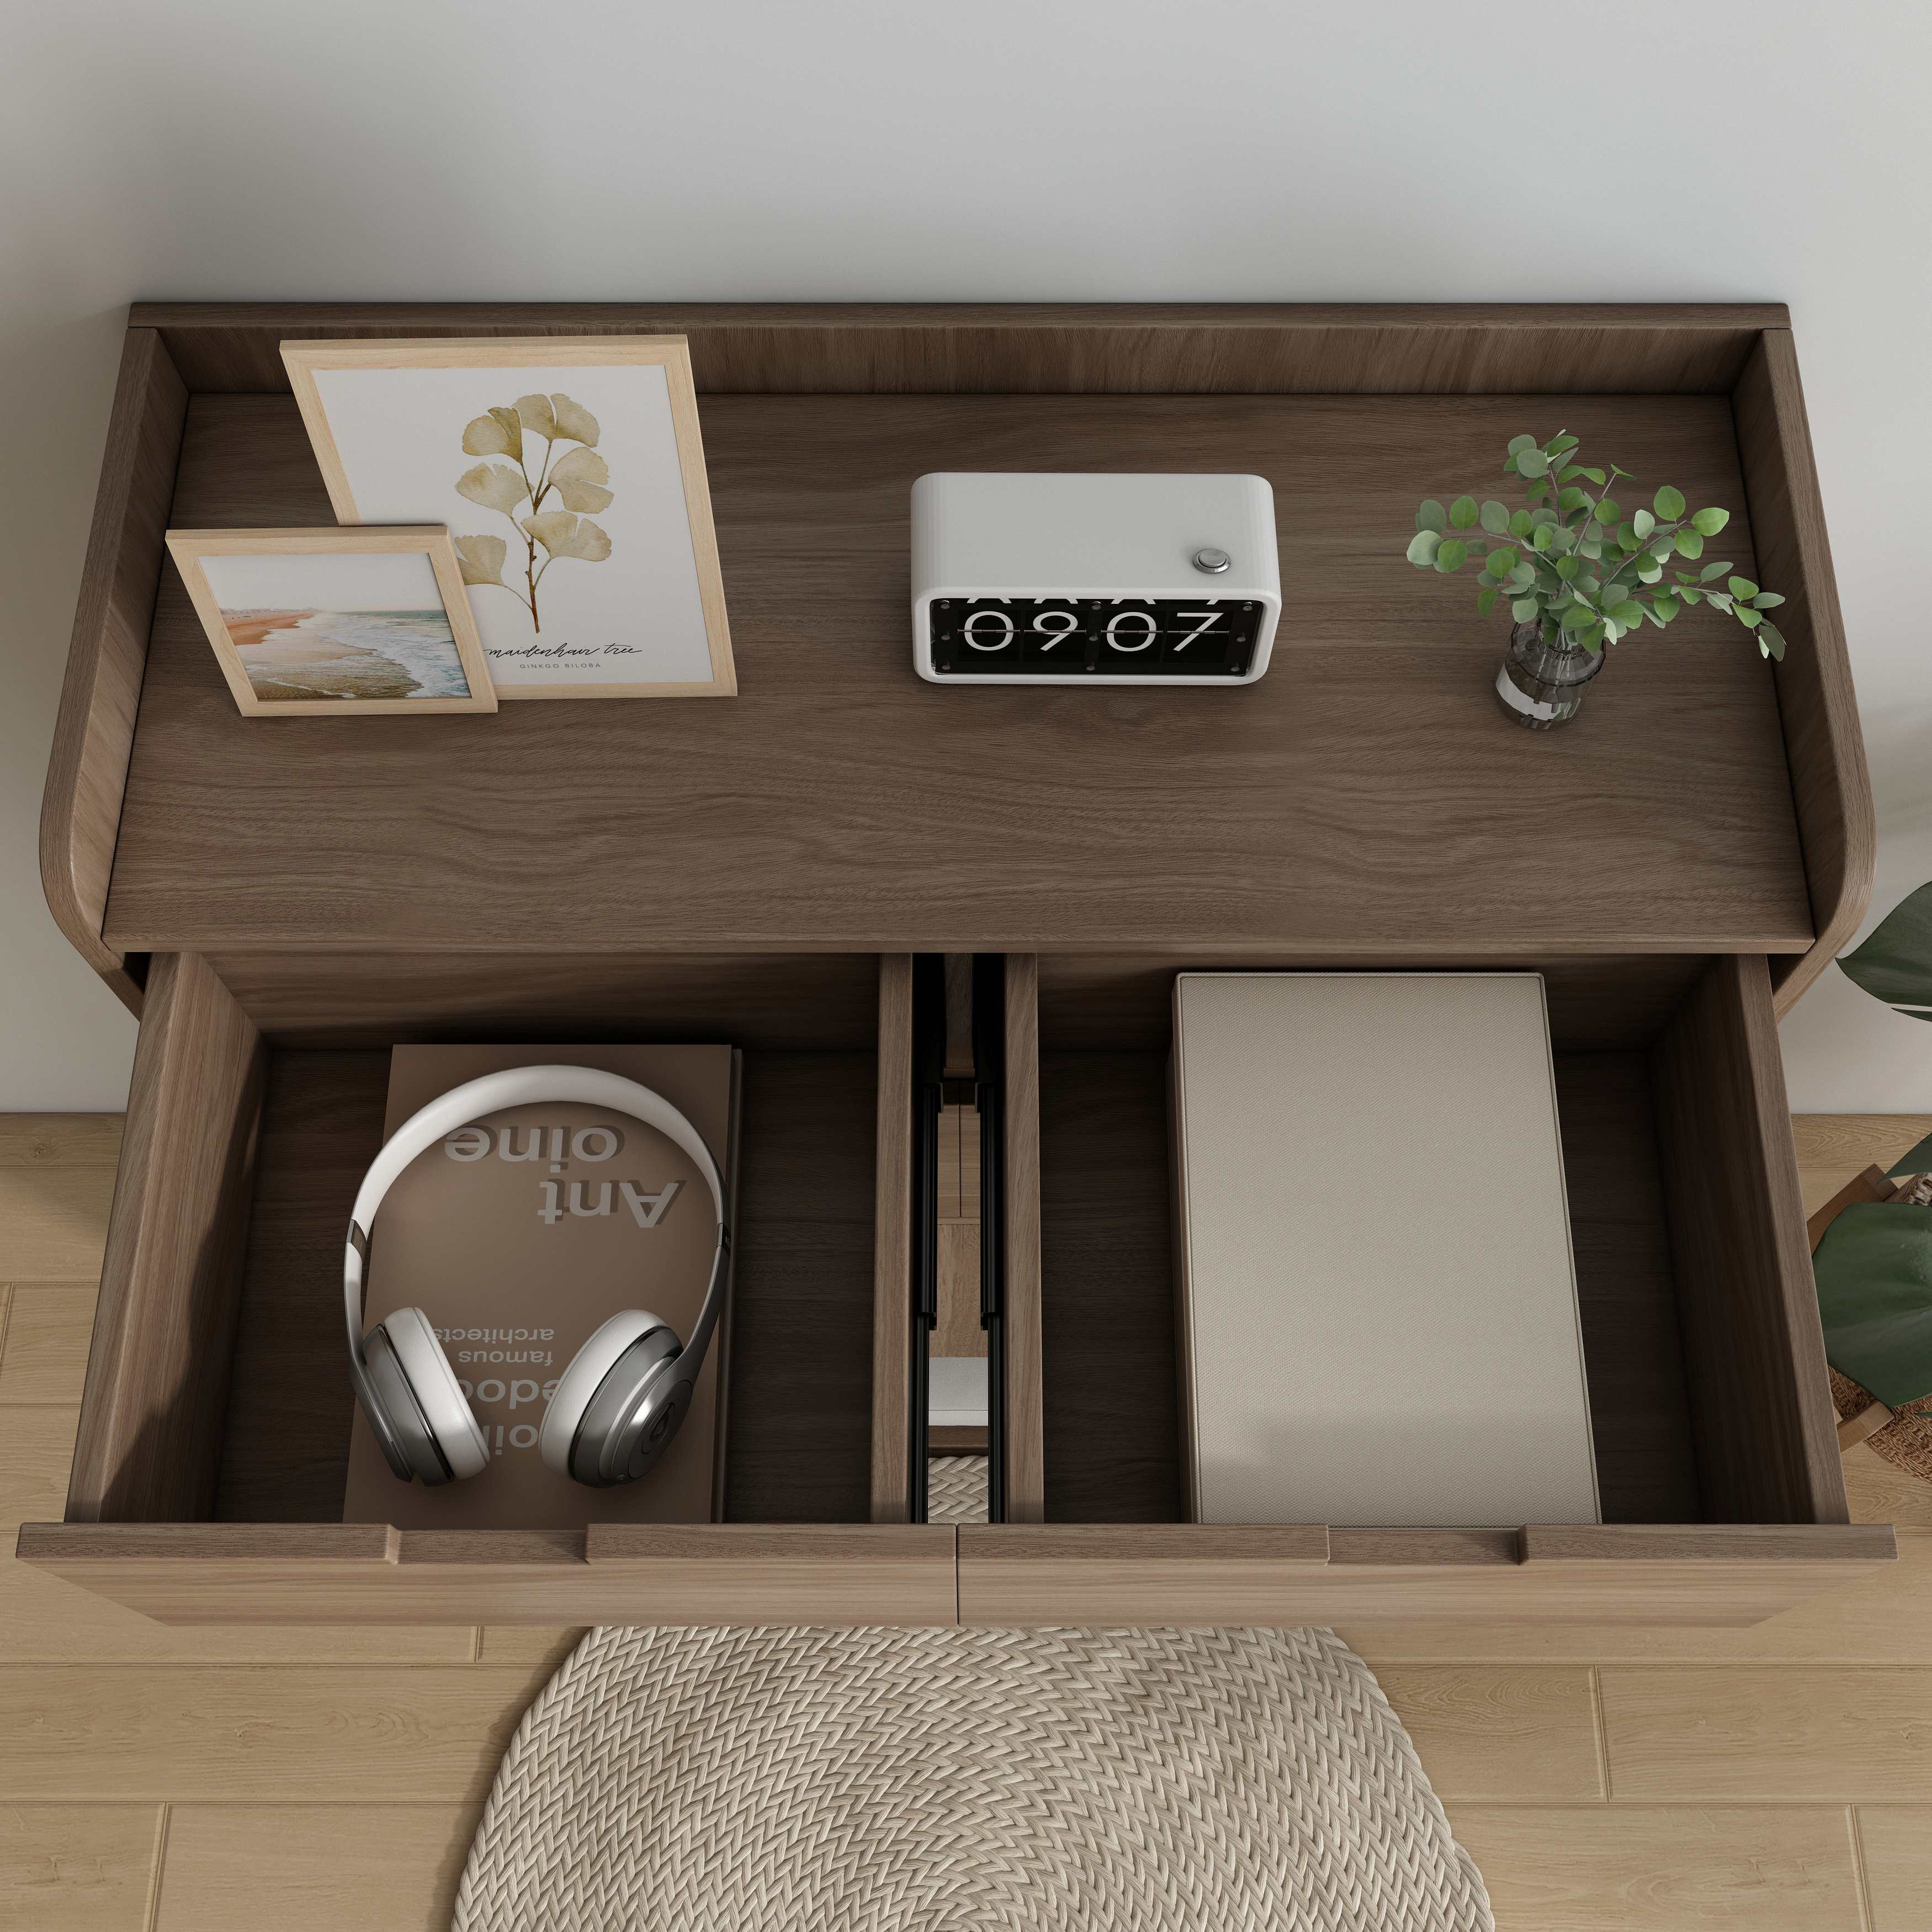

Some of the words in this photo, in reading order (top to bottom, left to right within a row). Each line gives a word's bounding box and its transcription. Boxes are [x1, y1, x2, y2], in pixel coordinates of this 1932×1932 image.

[483, 643, 600, 657] maidenhair
[604, 643, 643, 655] tree
[444, 1127, 618, 1173] oine
[537, 1181, 680, 1228] Ant
[433, 1328, 555, 1344] architects
[458, 1351, 554, 1366] famous
